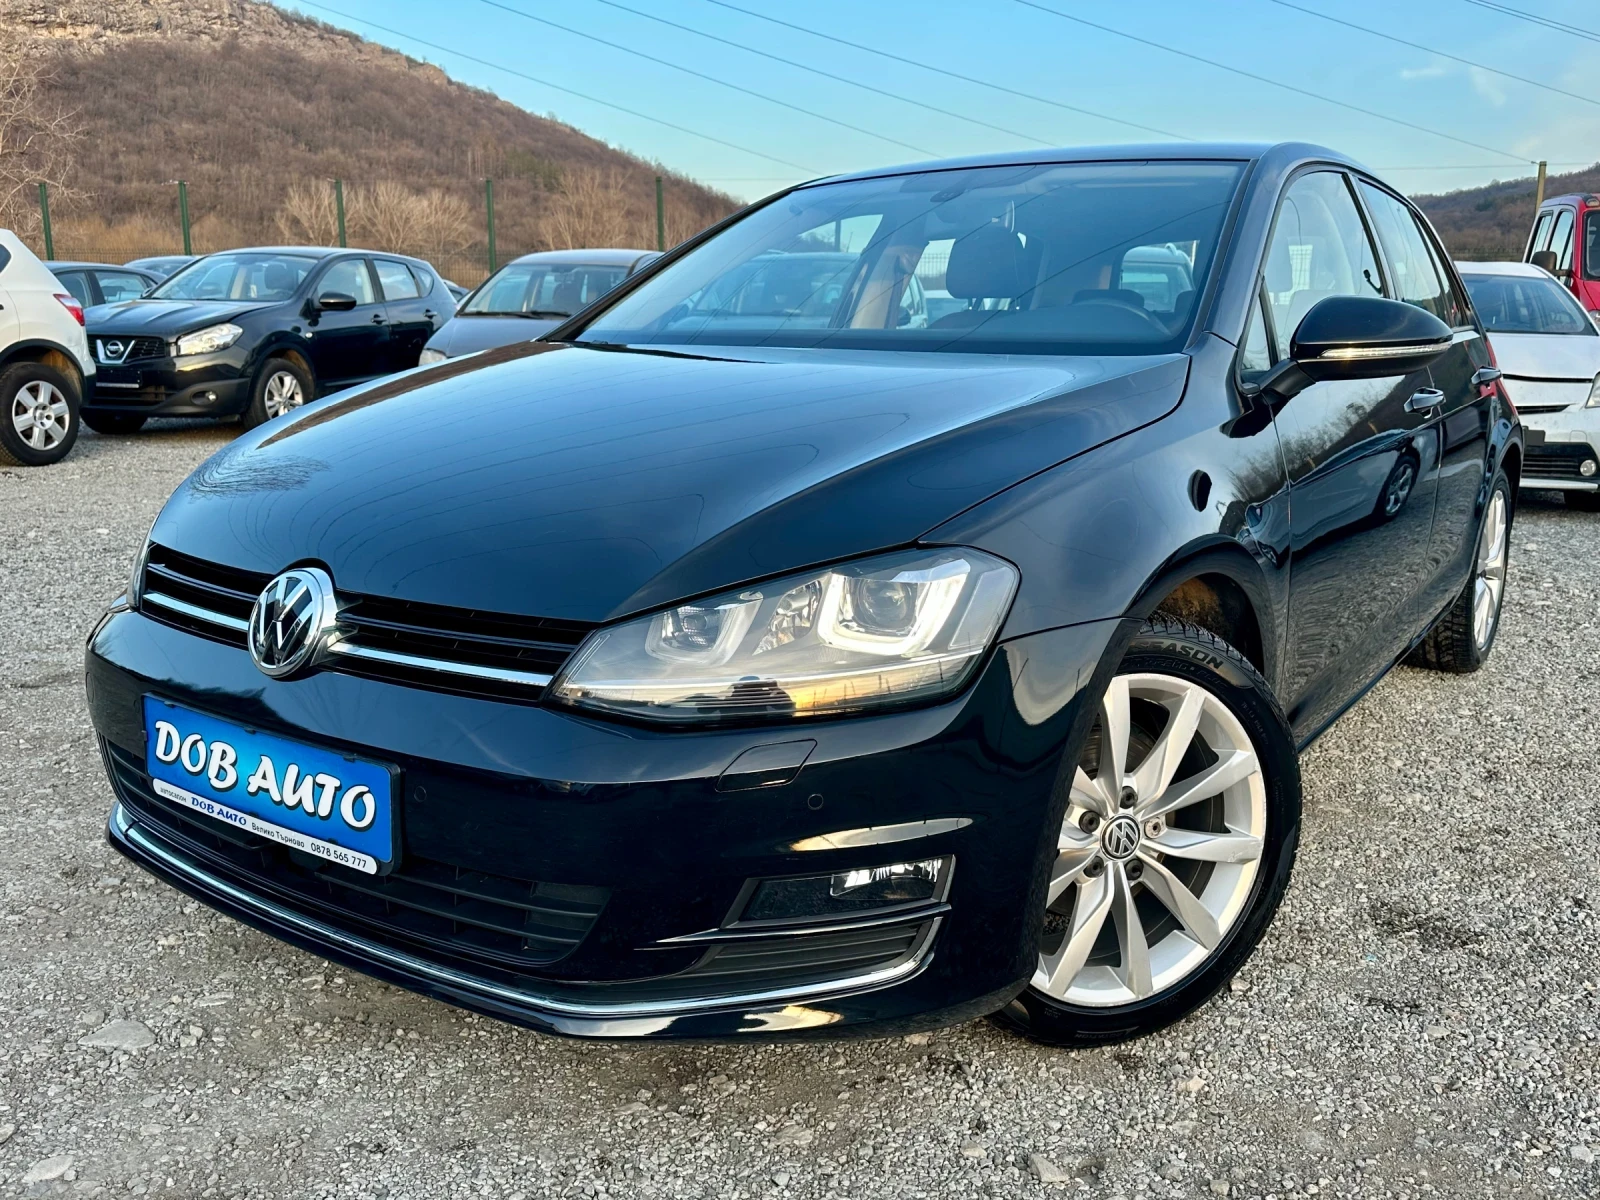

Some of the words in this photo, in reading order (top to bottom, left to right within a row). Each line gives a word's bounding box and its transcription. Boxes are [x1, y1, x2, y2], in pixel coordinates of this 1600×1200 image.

[155, 720, 240, 790] DOB
[246, 754, 377, 831] AUTO
[191, 796, 215, 814] DOB
[217, 808, 247, 826] AUTO
[251, 822, 275, 837] Велико
[275, 830, 305, 848] Търново
[310, 842, 331, 857] 0878
[333, 850, 349, 863] 565
[351, 855, 367, 868] 777
